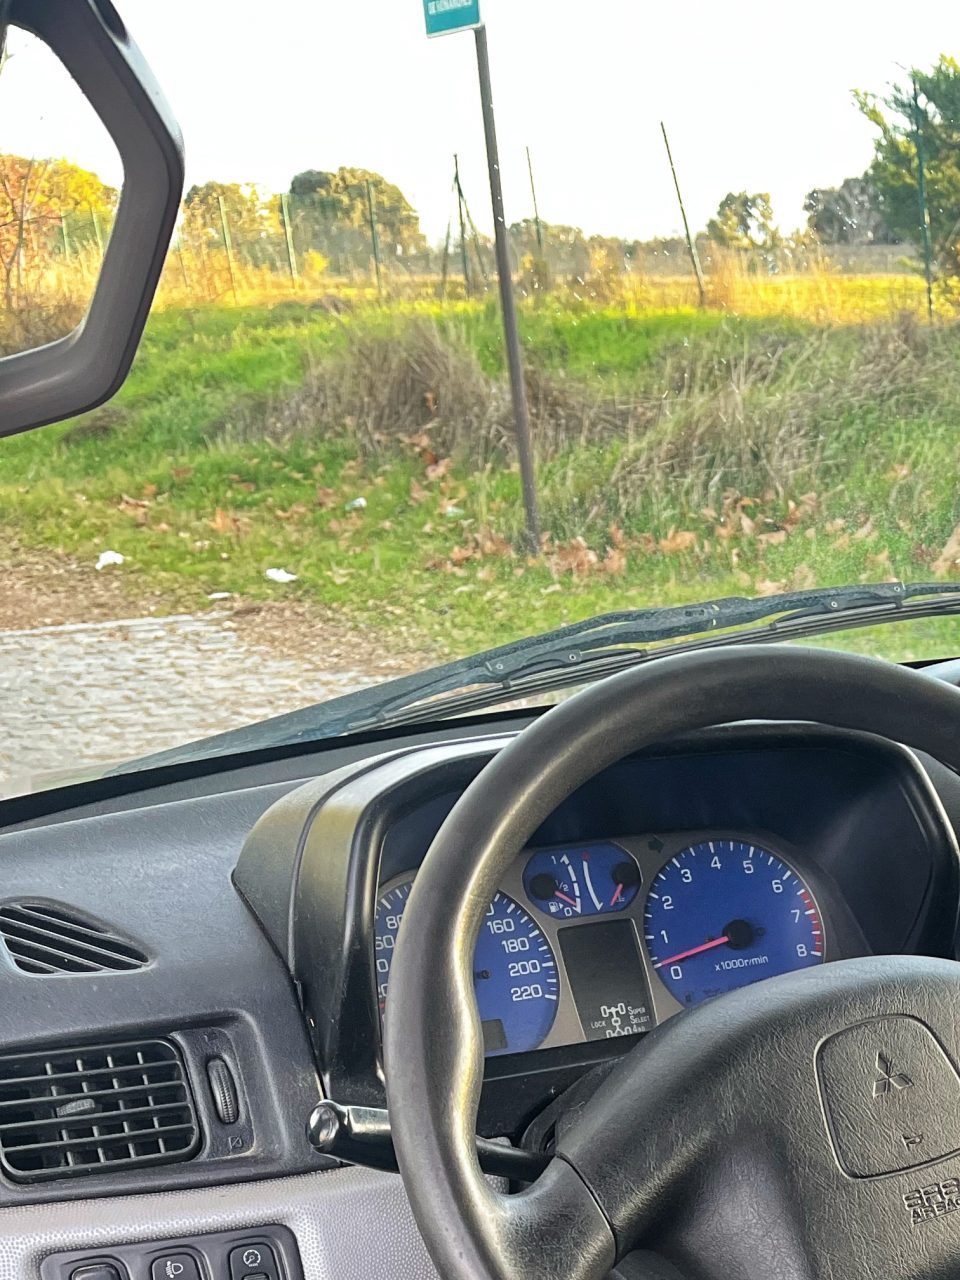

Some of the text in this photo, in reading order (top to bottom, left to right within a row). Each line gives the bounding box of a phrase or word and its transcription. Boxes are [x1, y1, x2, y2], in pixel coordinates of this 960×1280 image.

[710, 856, 722, 870] 4
[742, 860, 754, 874] 5
[680, 868, 692, 883] 3
[771, 880, 783, 893] 6
[661, 895, 674, 910] 2
[564, 906, 572, 917] 0
[790, 909, 801, 923] 7
[487, 918, 515, 934] 160
[660, 930, 669, 943] 1
[501, 938, 530, 953] 180
[796, 944, 807, 957] 8
[508, 960, 541, 977] 200
[714, 955, 769, 972] x1000r/min
[670, 965, 683, 980] 0
[510, 984, 543, 1002] 220
[590, 1020, 607, 1029] LOCK
